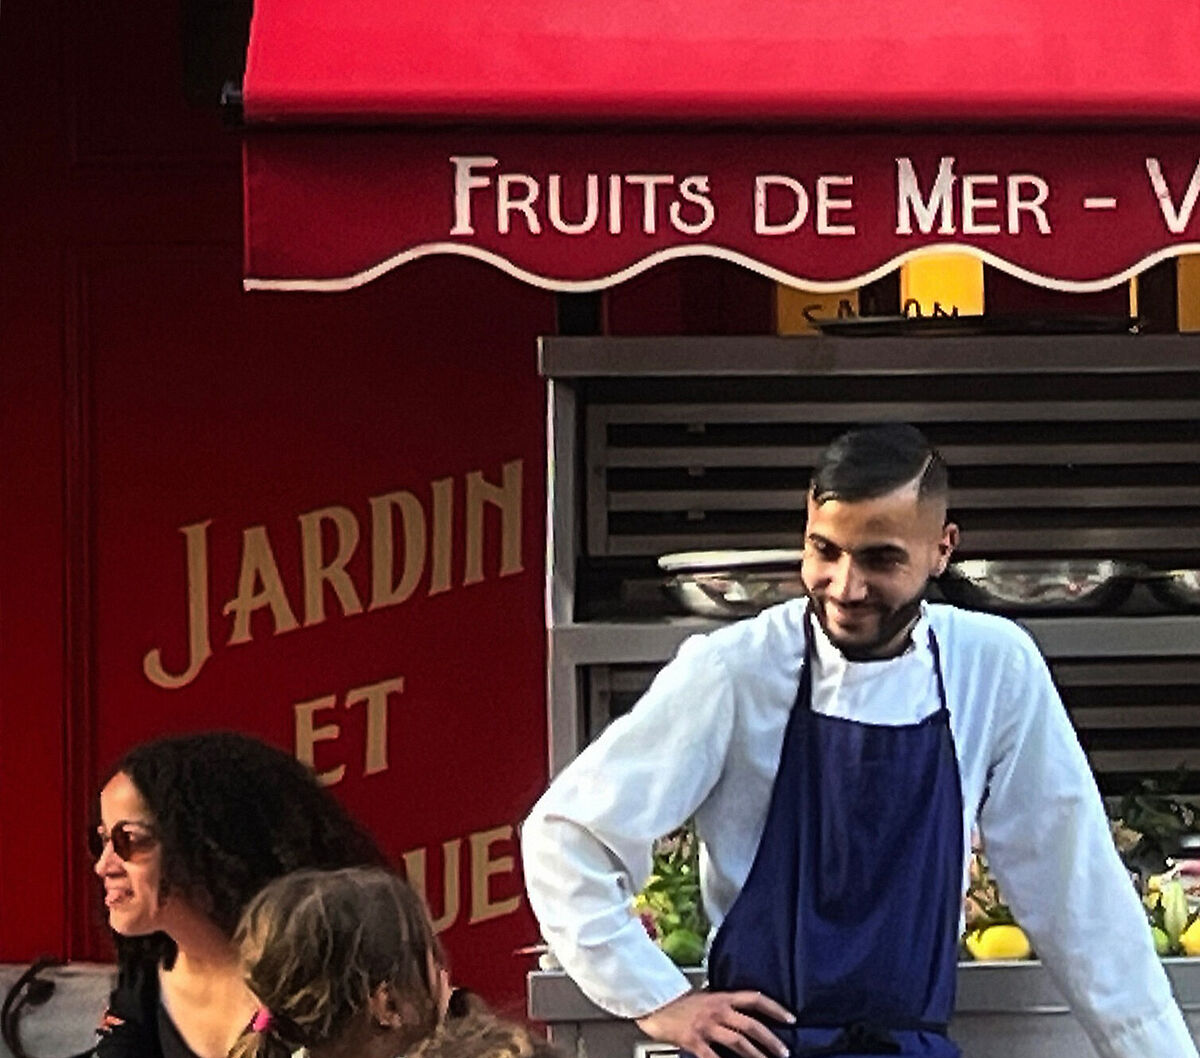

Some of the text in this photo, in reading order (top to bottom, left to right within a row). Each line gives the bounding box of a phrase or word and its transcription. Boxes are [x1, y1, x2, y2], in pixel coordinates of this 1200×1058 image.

[449, 156, 715, 235] FRUITS
[755, 175, 856, 235] DE
[895, 156, 1052, 235] MER
[1083, 197, 1117, 209] -
[142, 458, 525, 689] JARDIN
[294, 677, 405, 787] ET
